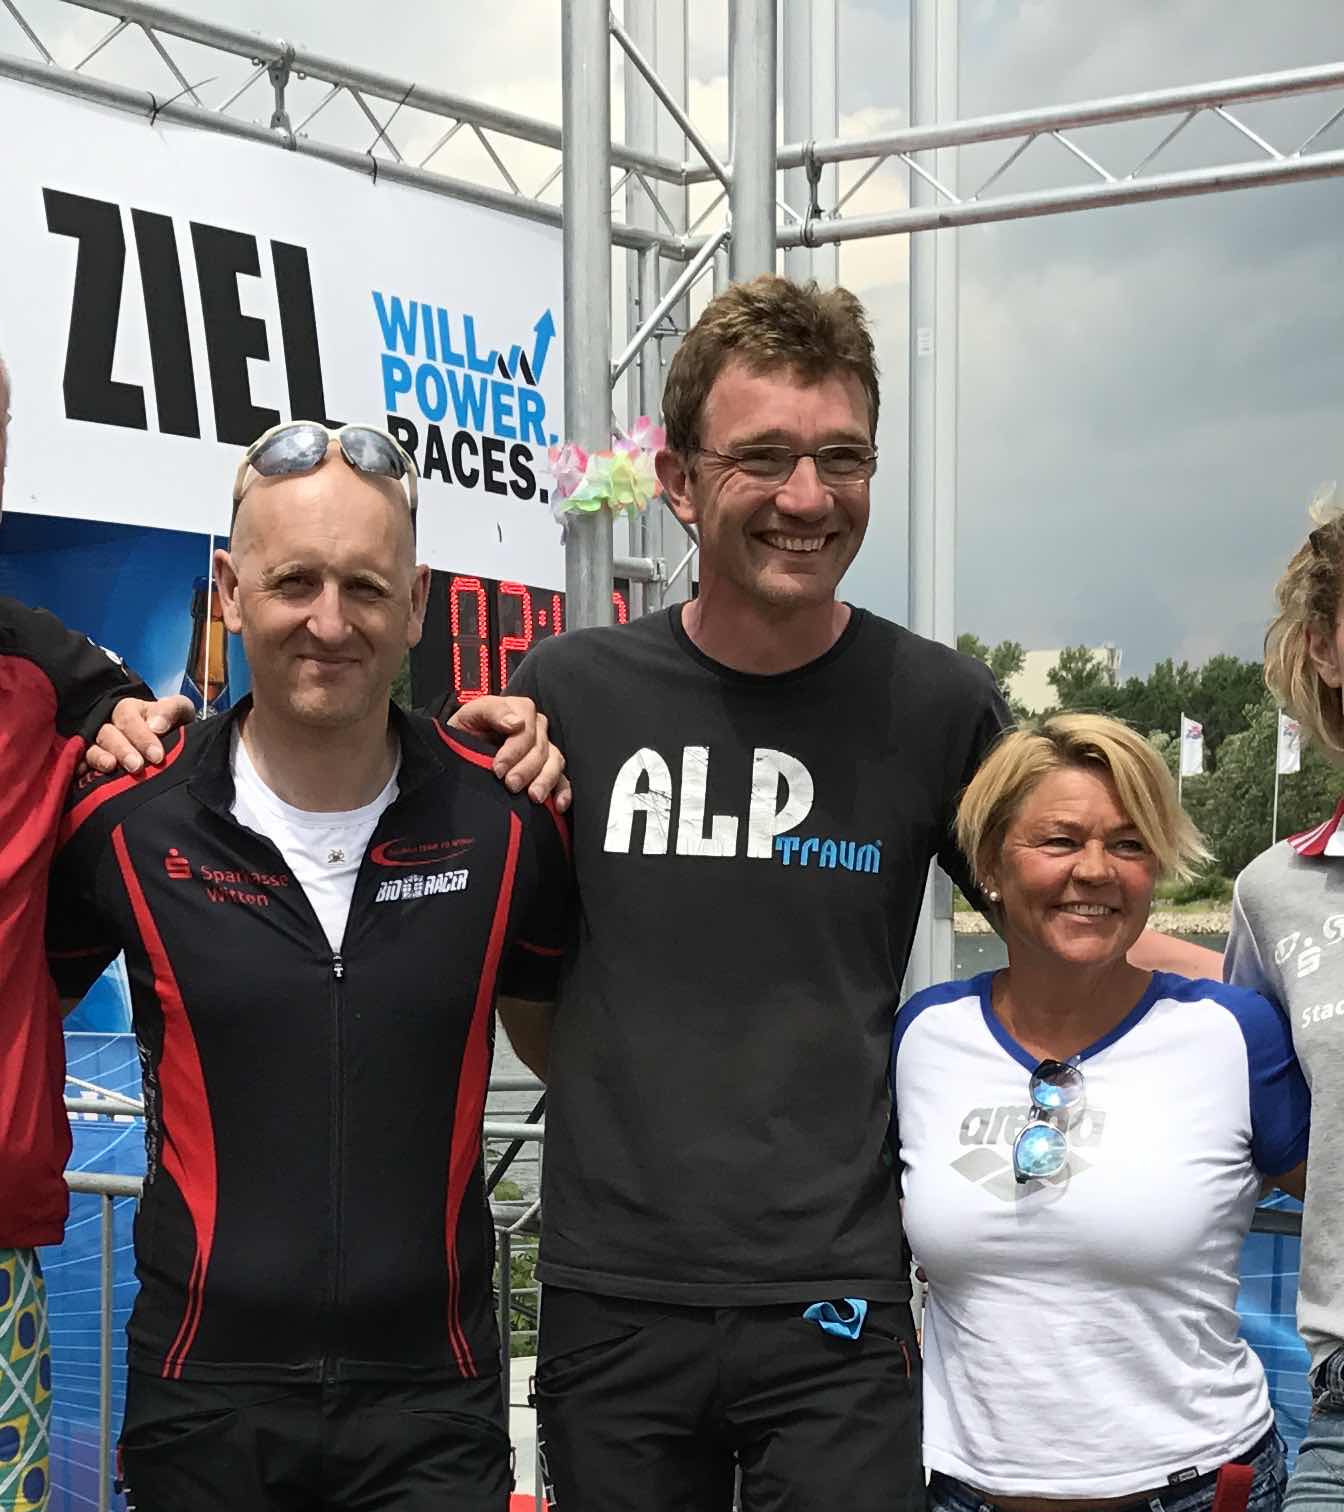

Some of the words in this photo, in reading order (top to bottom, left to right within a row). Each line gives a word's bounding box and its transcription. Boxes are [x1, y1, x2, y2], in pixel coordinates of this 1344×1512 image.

[42, 187, 348, 448] ZIEL
[371, 290, 499, 376] WILL
[381, 353, 560, 447] POWER.
[386, 414, 549, 505] RACES.
[603, 745, 815, 860] ALP
